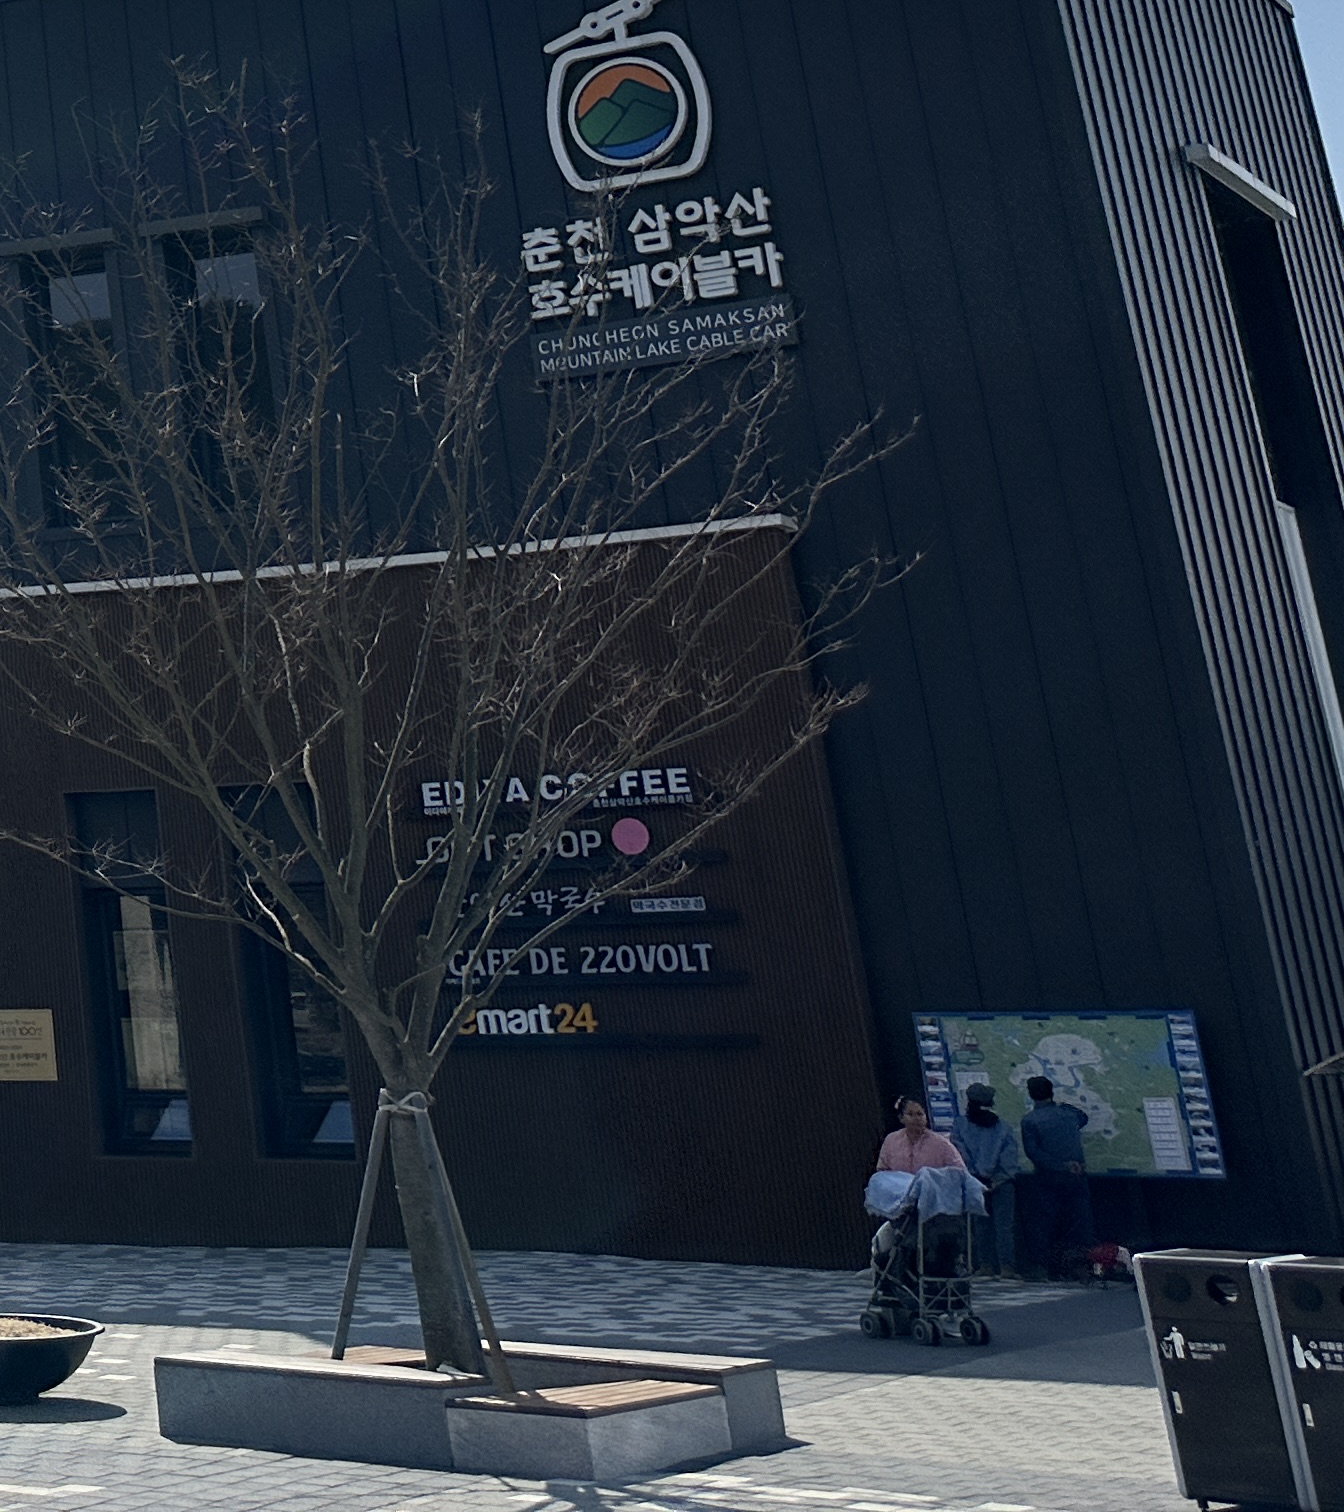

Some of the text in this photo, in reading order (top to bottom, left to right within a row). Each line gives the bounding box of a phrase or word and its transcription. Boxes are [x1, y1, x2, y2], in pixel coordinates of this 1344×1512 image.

[522, 186, 772, 273] 춘천 삼악산
[527, 241, 785, 321] 호수케이블카
[667, 302, 786, 336] SAMAKSAN
[636, 339, 682, 360] LAKE
[686, 327, 744, 351] CABLE
[749, 321, 789, 344] CAR
[421, 766, 692, 807] EDA CFEE
[448, 942, 713, 977] CAFE DE 220VOLT
